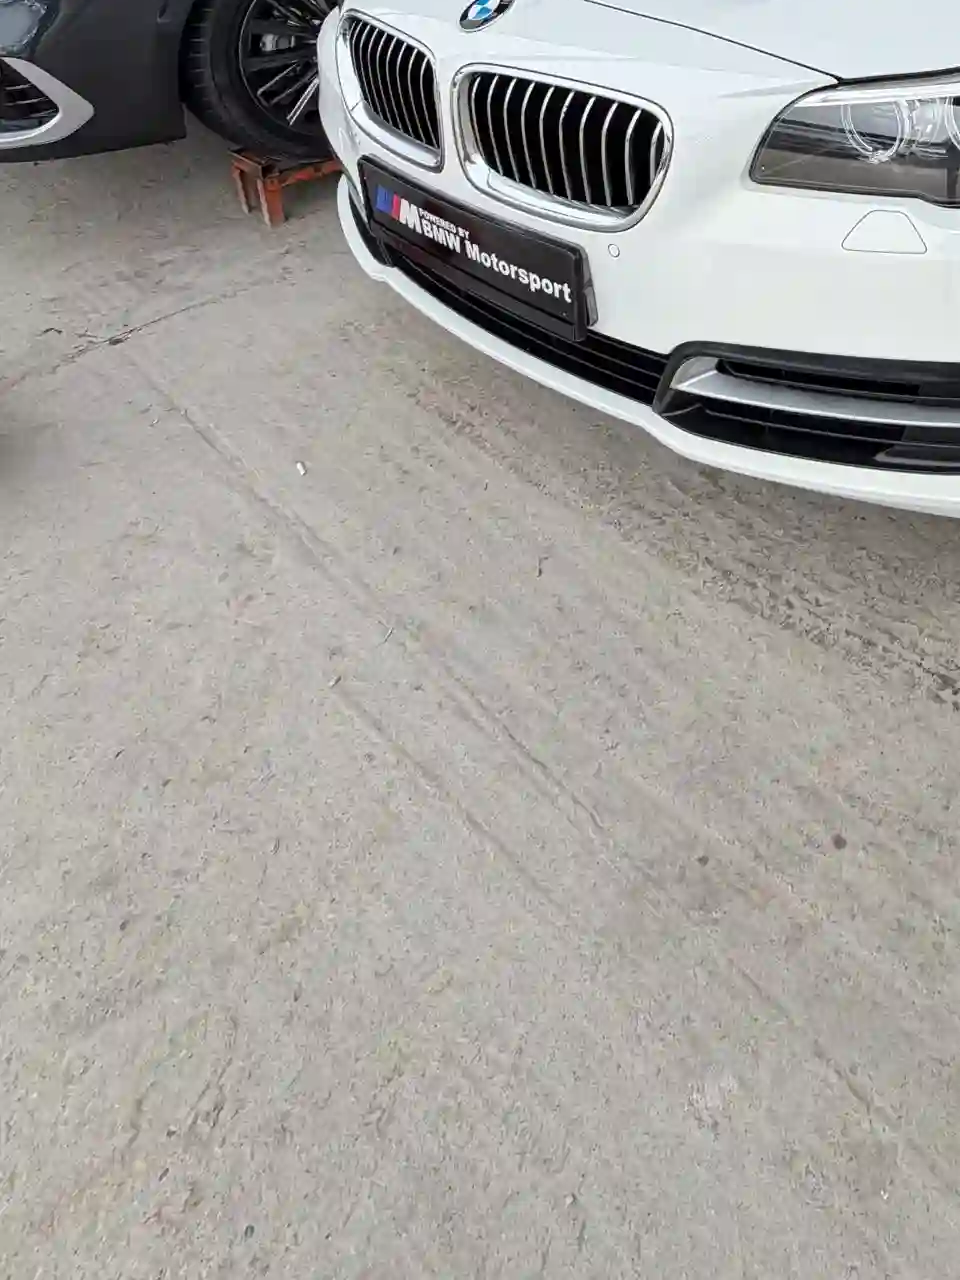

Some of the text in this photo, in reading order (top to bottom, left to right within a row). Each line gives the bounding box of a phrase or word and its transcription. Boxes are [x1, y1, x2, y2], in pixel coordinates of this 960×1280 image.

[399, 198, 422, 234] M
[419, 207, 457, 234] POWERED
[420, 218, 572, 304] BMW Motorsport
